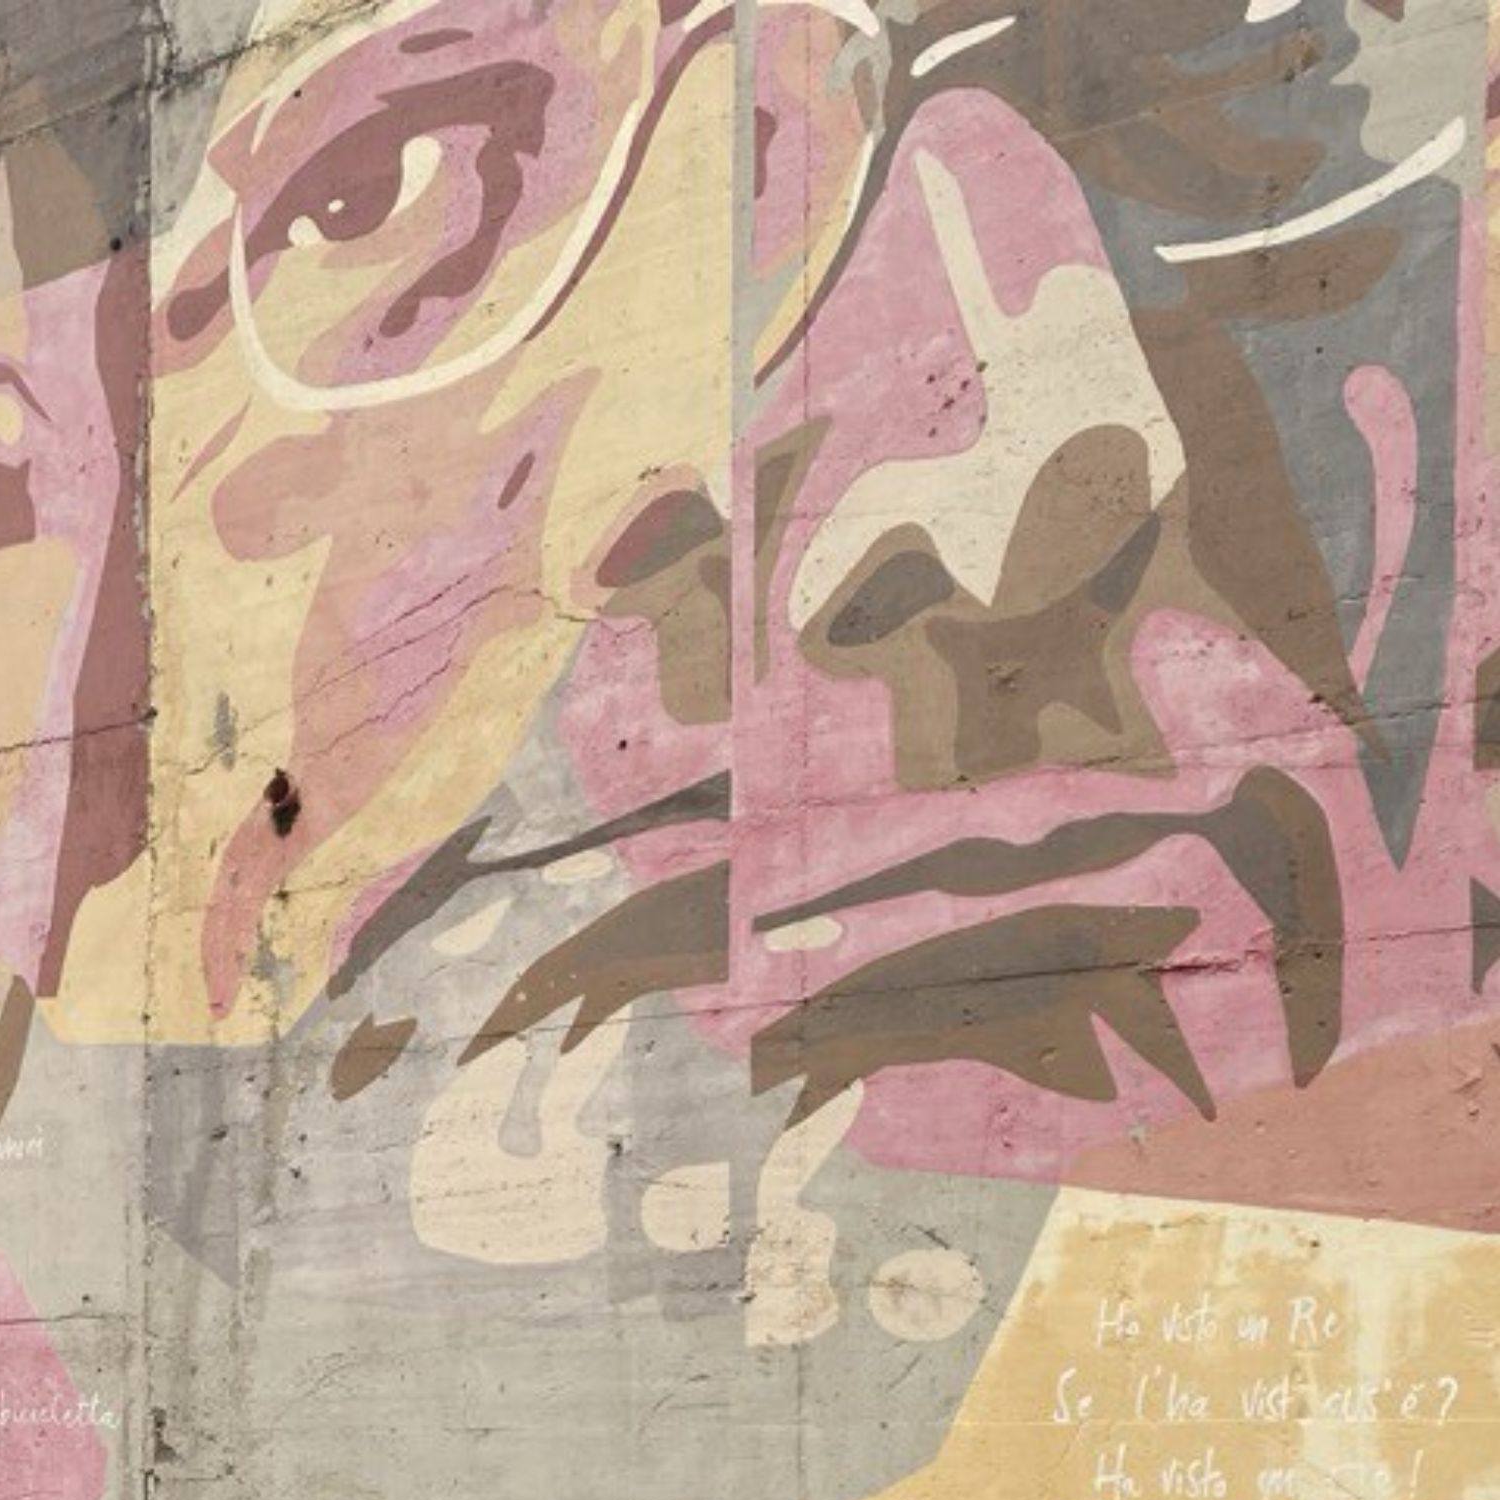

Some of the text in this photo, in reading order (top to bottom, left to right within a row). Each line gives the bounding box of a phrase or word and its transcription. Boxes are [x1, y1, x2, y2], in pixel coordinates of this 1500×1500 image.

[1096, 1290, 1342, 1348] Ho visto un Re
[1052, 1367, 1093, 1424] Se
[1161, 1447, 1228, 1500] visto
